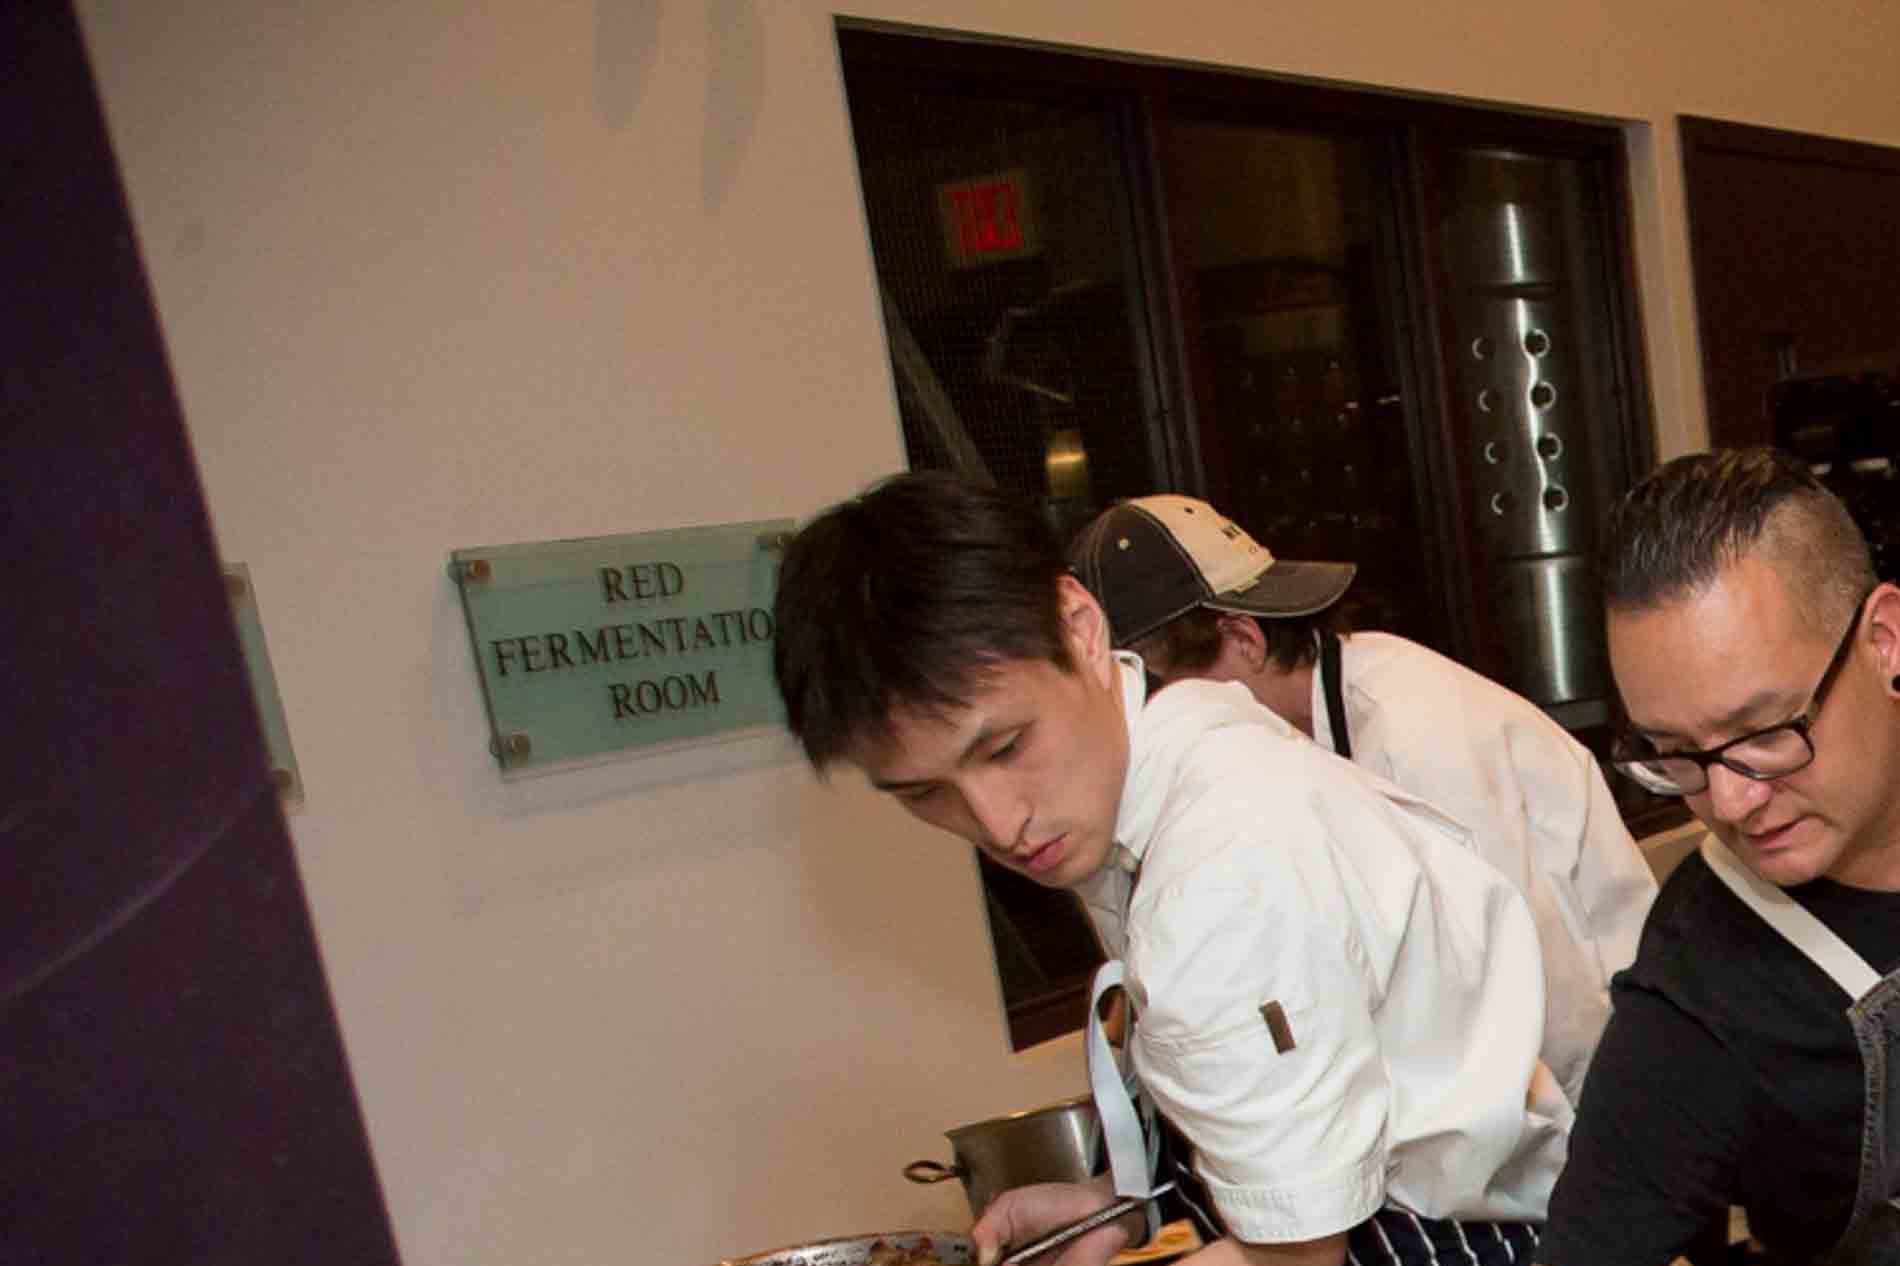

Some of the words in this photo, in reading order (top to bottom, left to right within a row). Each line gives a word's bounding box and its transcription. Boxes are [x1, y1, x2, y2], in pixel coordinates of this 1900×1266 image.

[599, 562, 683, 603] RED
[489, 607, 777, 676] FERMENTATIO
[608, 670, 721, 720] ROOM
